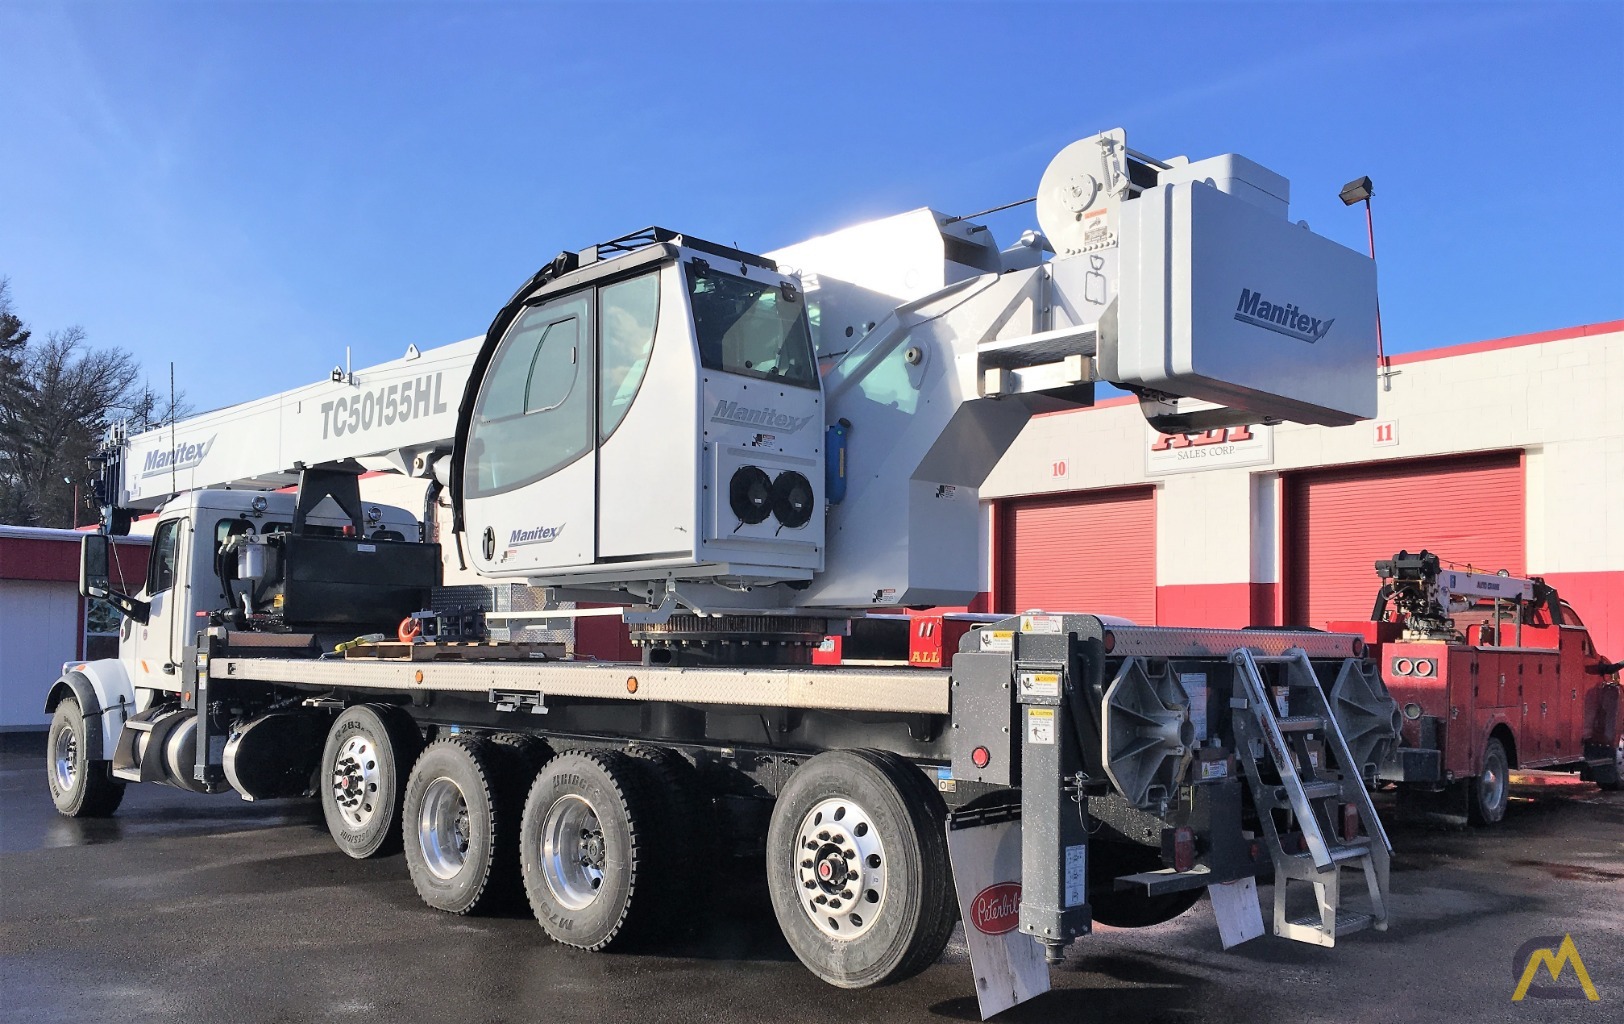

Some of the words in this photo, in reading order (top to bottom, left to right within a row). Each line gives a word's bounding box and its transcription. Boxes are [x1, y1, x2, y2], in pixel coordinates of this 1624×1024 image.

[1237, 288, 1321, 336] Manitex
[321, 372, 447, 440] TC50155HL
[714, 399, 801, 432] Manitex
[1376, 424, 1392, 442] 11
[143, 440, 207, 471] Manitex
[1177, 448, 1207, 460] SALES
[1209, 445, 1235, 457] CORP.
[1052, 461, 1066, 476] 10
[509, 526, 557, 543] Manitex
[911, 651, 940, 663] ALL
